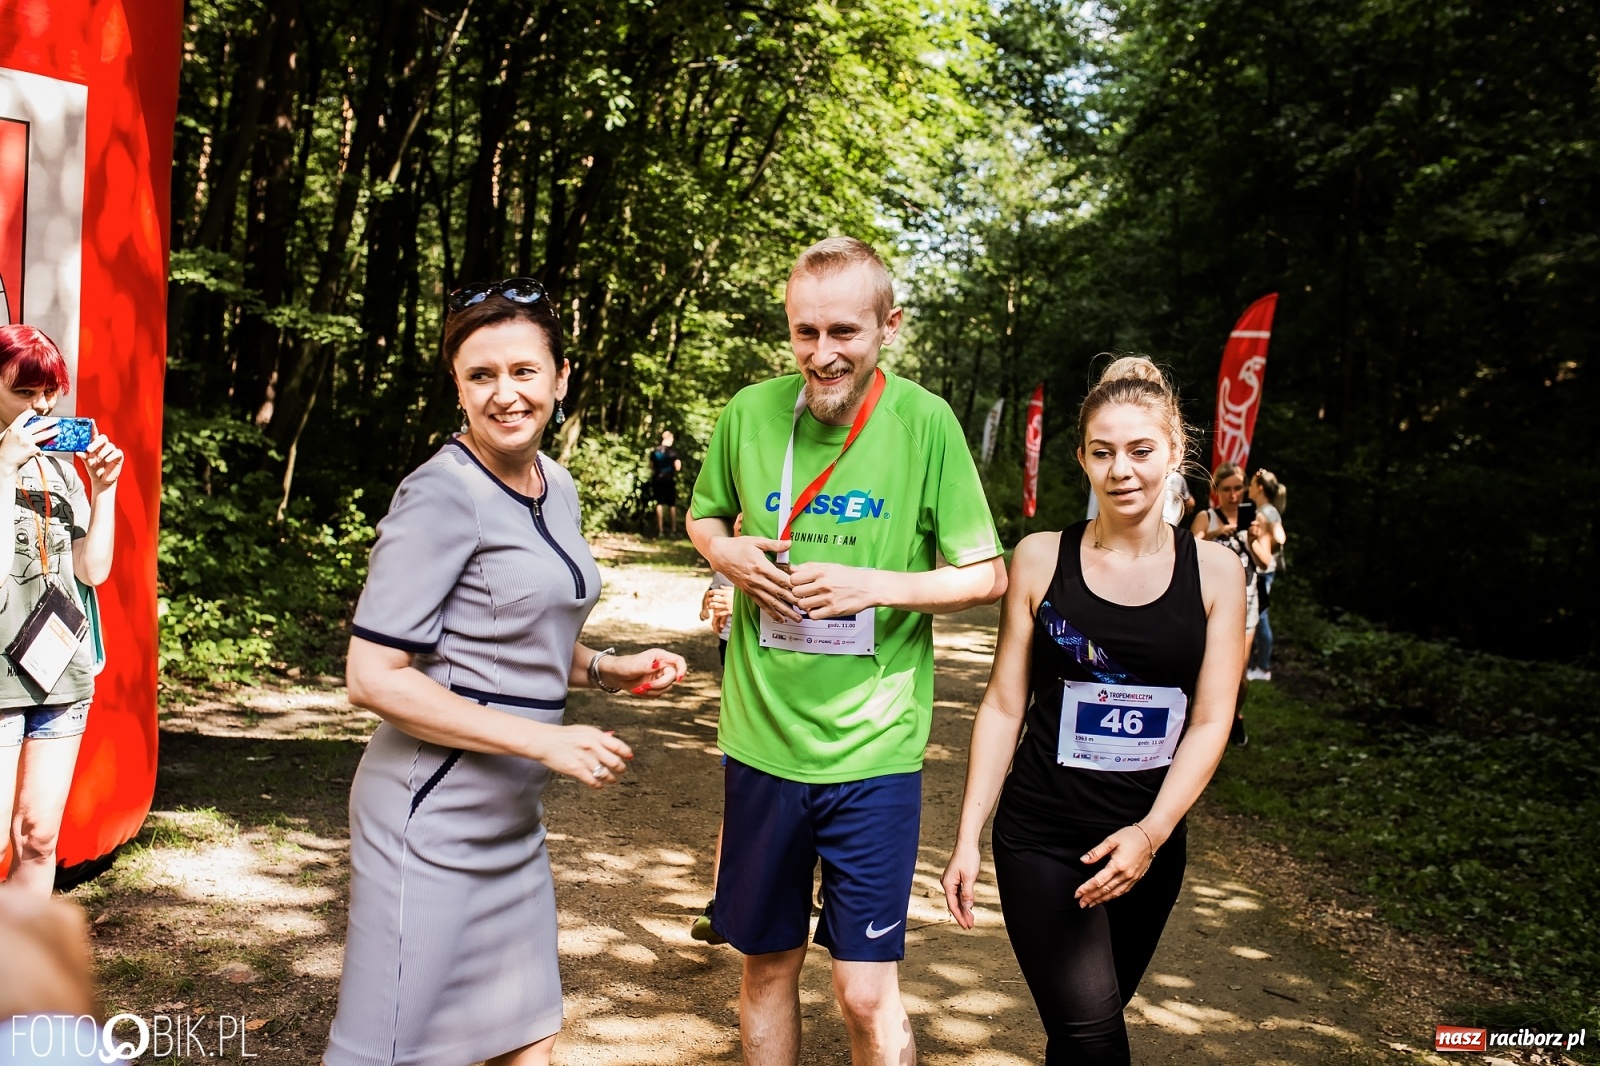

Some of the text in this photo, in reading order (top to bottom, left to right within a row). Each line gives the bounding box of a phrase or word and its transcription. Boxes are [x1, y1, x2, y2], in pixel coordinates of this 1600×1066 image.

[766, 491, 885, 519] CSSEN
[833, 535, 857, 546] TEAM
[1100, 708, 1144, 735] 46
